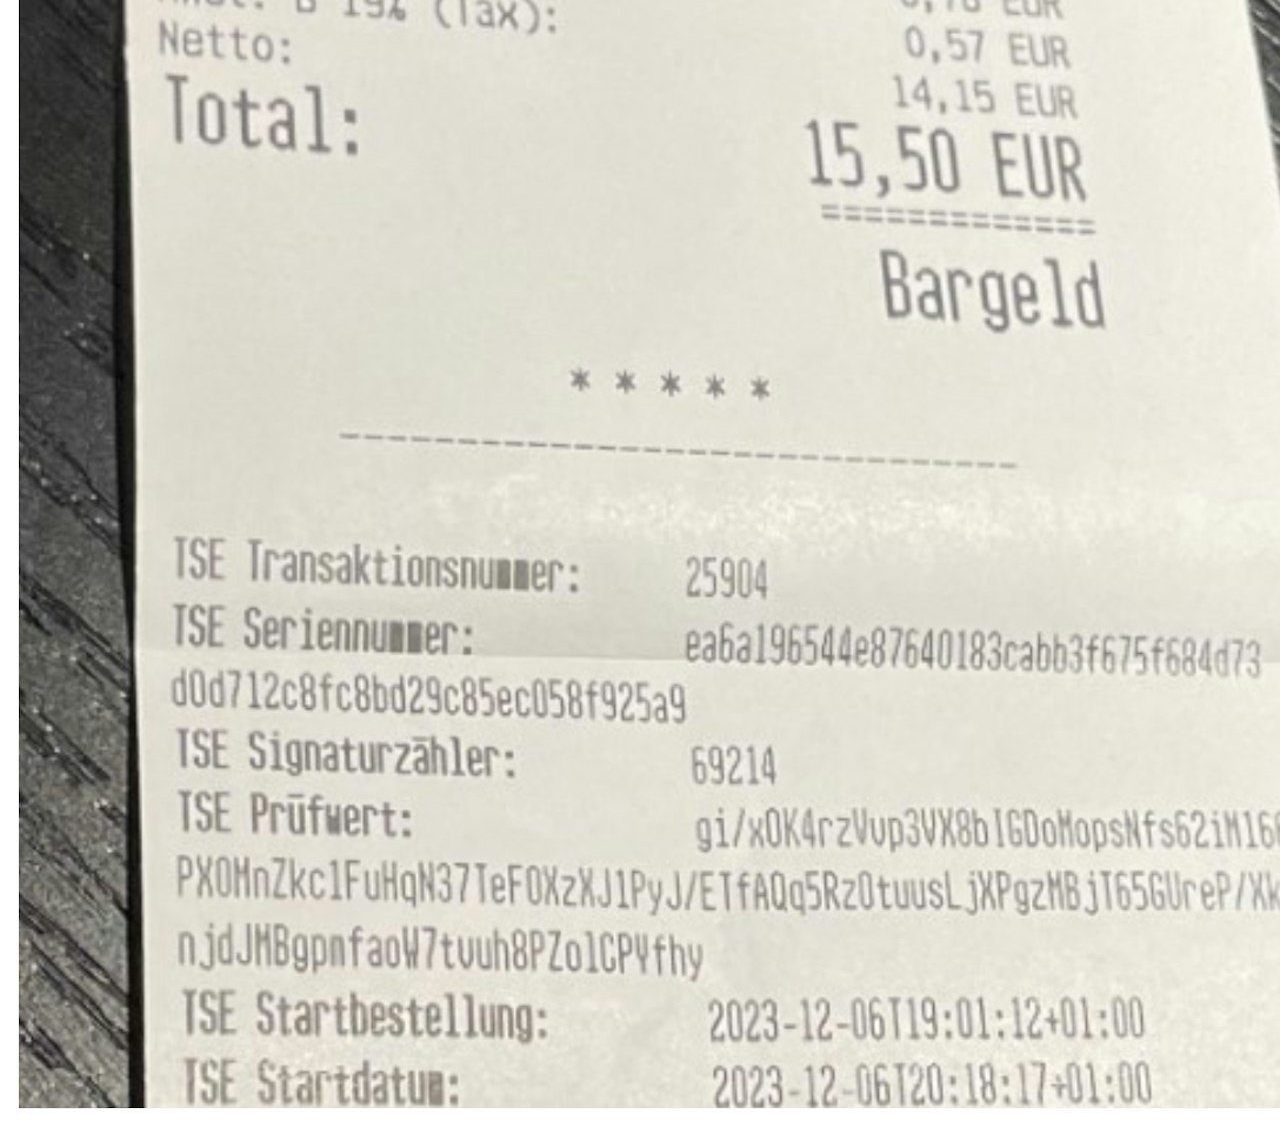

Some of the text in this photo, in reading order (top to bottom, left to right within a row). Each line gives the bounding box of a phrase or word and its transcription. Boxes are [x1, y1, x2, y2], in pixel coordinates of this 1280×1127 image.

[158, 18, 1079, 120] Netto: 14,15 EUR
[903, 23, 985, 66] 0,57
[1007, 30, 1072, 70] EUR
[165, 72, 1087, 203] Total: 15,50 EUR
[879, 247, 1106, 335] Bargeld
[174, 535, 768, 600] TSE Transaktionsnummer: 25904
[172, 602, 225, 649] TSE
[243, 605, 473, 657] Seriennummer:
[176, 726, 777, 787] TSE Signaturzähler: 69214
[178, 789, 232, 834] TSE
[249, 790, 412, 839] Prüfwert:
[182, 988, 1146, 1045] TSE Startbestellung: 2023-12-06T19:01:12+01:00
[183, 1056, 1153, 1107] TSE Startdatum: 2023-12-06T20:18:17+01:00
